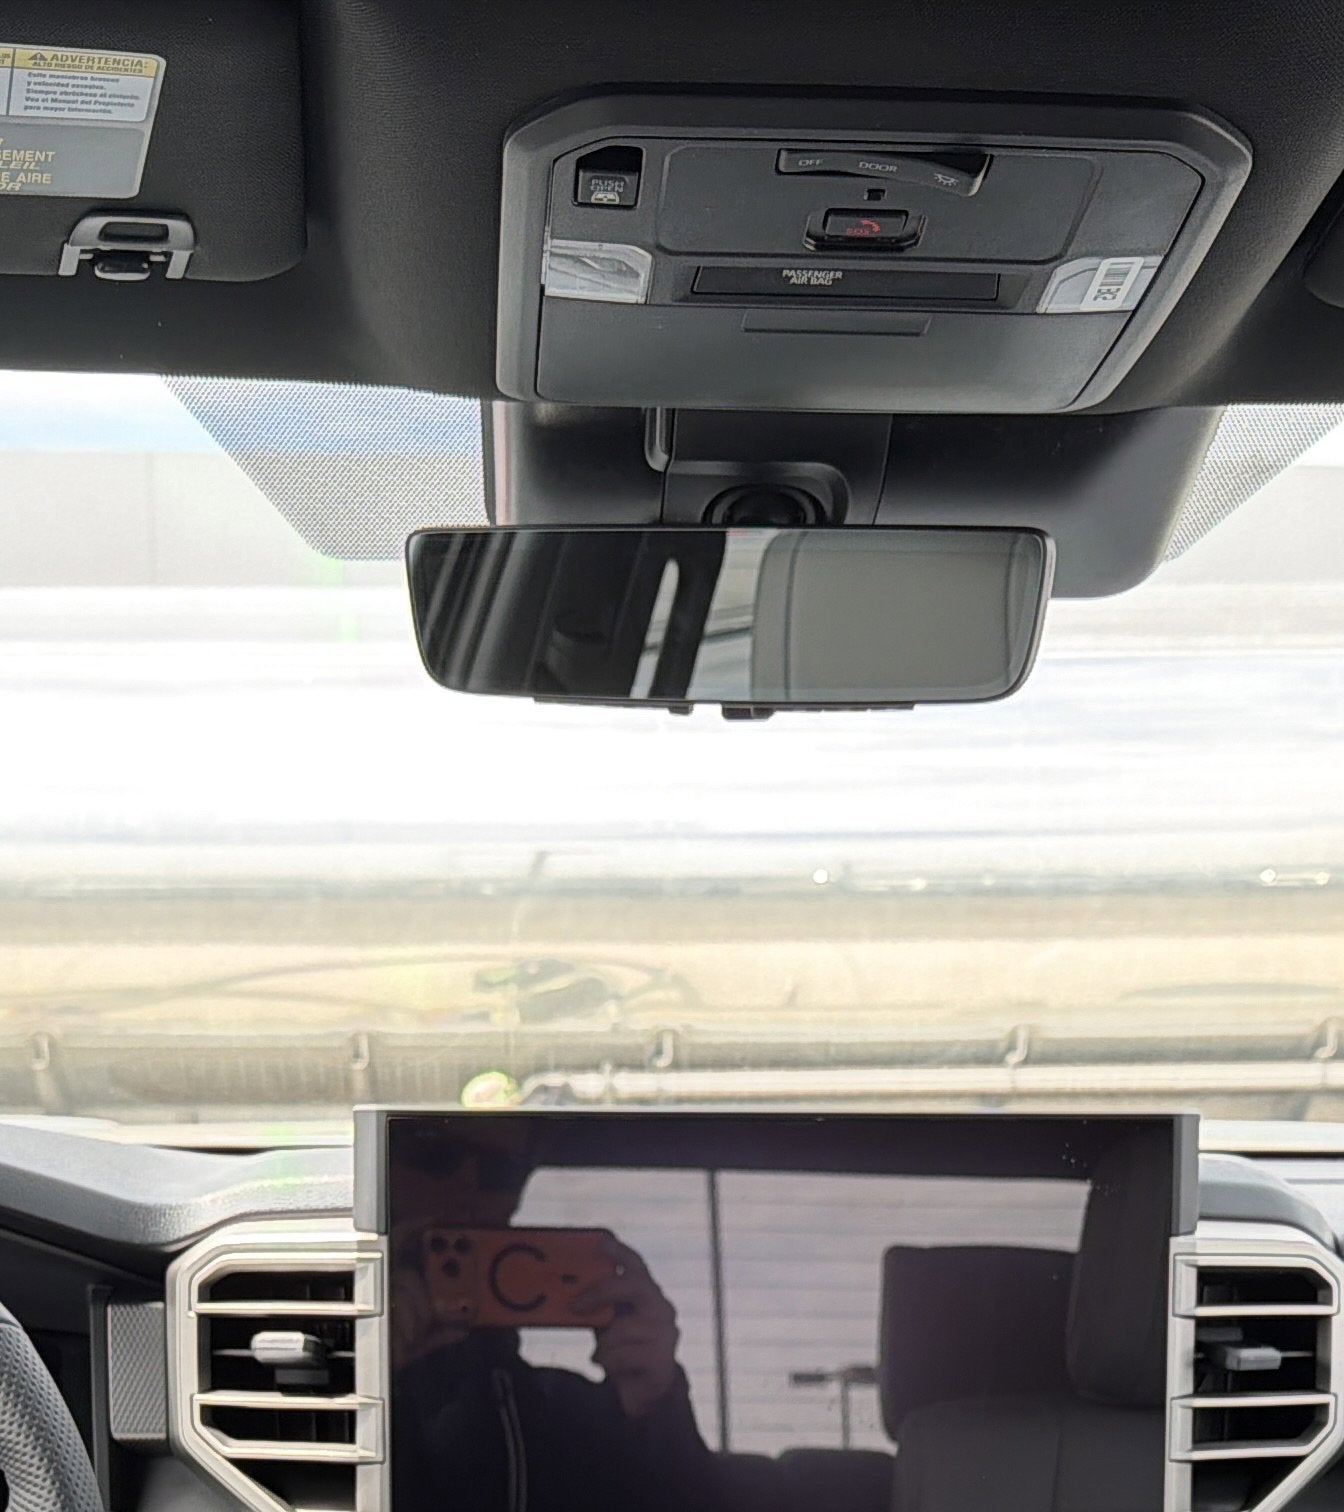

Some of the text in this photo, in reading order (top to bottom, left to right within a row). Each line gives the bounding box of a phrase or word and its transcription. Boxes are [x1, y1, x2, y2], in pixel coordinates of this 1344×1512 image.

[858, 161, 899, 172] DOOR
[16, 172, 52, 184] AIRE
[592, 179, 624, 187] PUSH
[782, 269, 843, 280] PASSENGER
[810, 277, 832, 286] BAG
